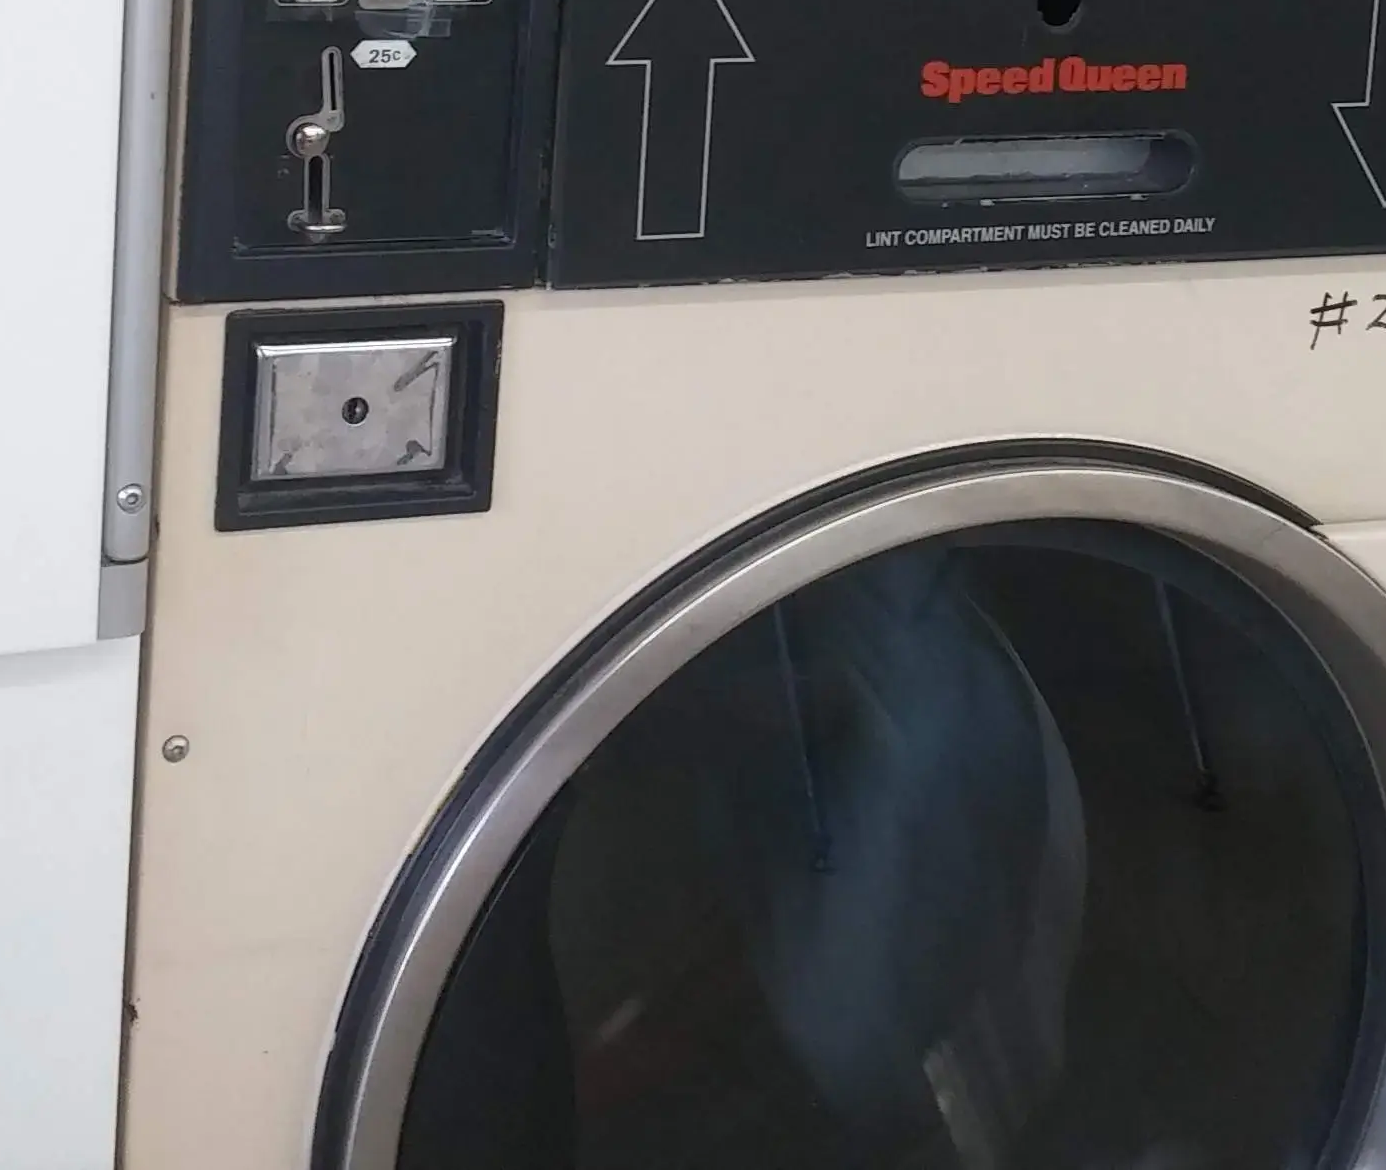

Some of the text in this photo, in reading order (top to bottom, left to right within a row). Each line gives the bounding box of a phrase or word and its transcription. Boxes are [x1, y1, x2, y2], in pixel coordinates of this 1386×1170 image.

[921, 55, 1188, 103] Speed Queen
[865, 217, 1216, 248] LINT COMPARTMENT MUST BE CLEANED DAILY
